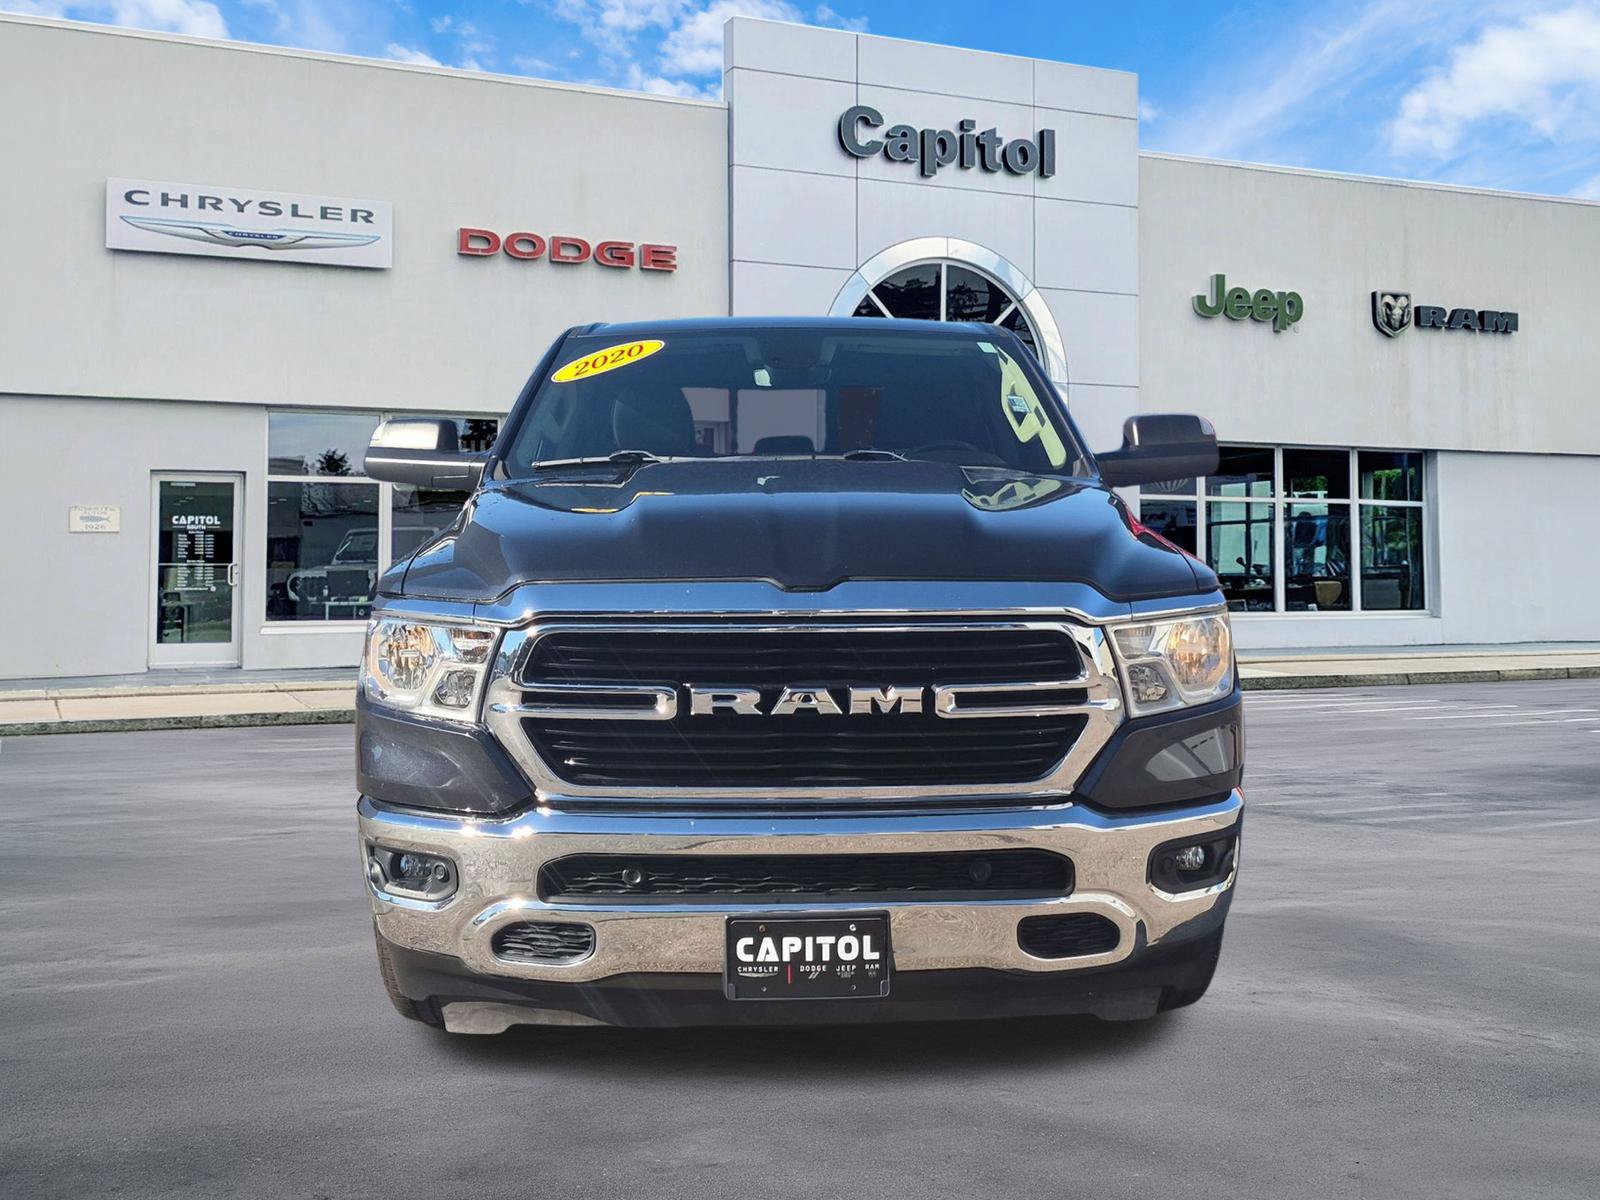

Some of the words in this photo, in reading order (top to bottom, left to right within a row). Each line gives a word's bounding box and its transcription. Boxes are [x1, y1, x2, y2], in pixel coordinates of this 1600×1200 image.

[838, 105, 1056, 178] Capitol
[124, 189, 376, 224] CHRYSLER
[457, 227, 678, 272] DODGE
[1192, 273, 1304, 333] Jeep
[1414, 305, 1519, 333] RAM
[574, 344, 644, 376] 2020
[172, 515, 221, 525] CAPITOL
[689, 685, 924, 715] RAM
[736, 935, 880, 962] CAPITOL
